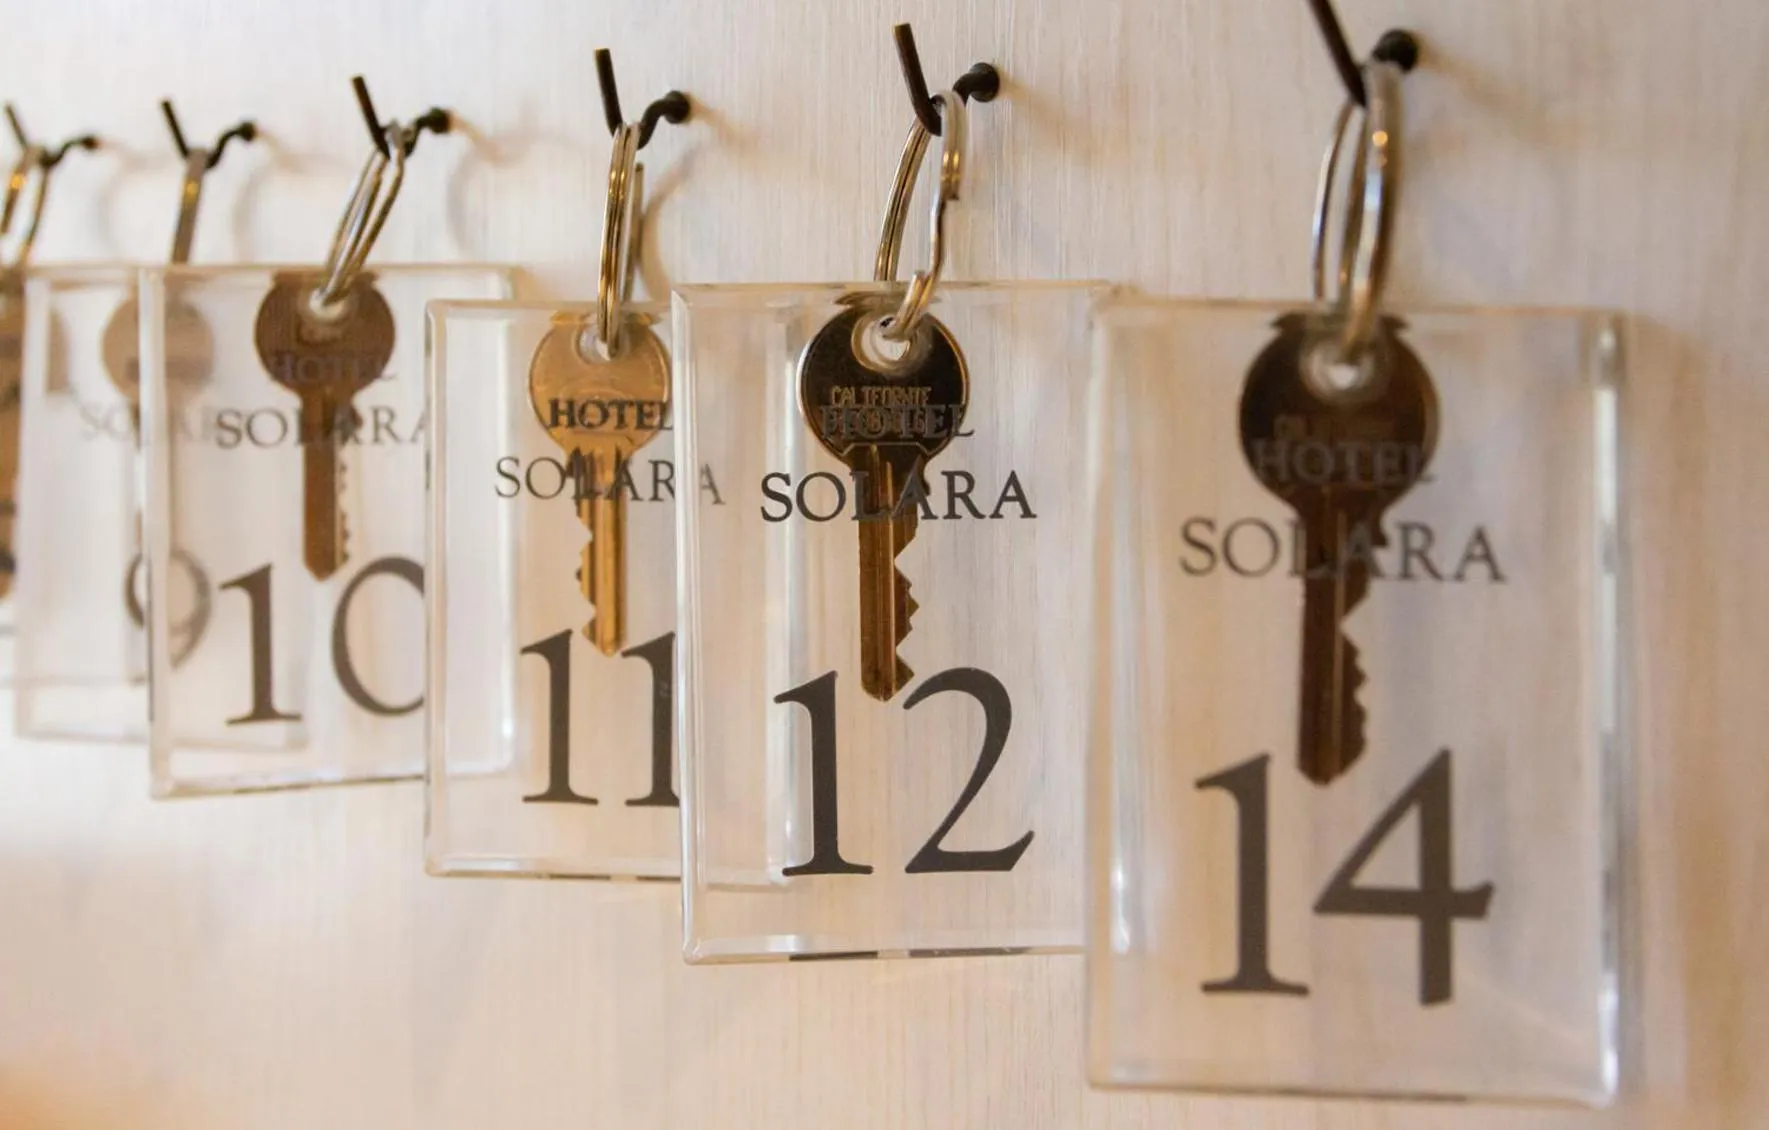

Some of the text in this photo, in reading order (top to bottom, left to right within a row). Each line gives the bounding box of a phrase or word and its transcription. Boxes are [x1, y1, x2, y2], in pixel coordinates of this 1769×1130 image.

[548, 397, 673, 431] HOTEL
[820, 404, 975, 439] HOTEL
[1250, 437, 1438, 485] HOTEL
[760, 470, 1037, 522] SOLARA
[1178, 517, 1507, 585] SOLARA
[520, 629, 681, 807] 11
[773, 667, 1034, 877] 12
[1195, 749, 1495, 1007] 14
